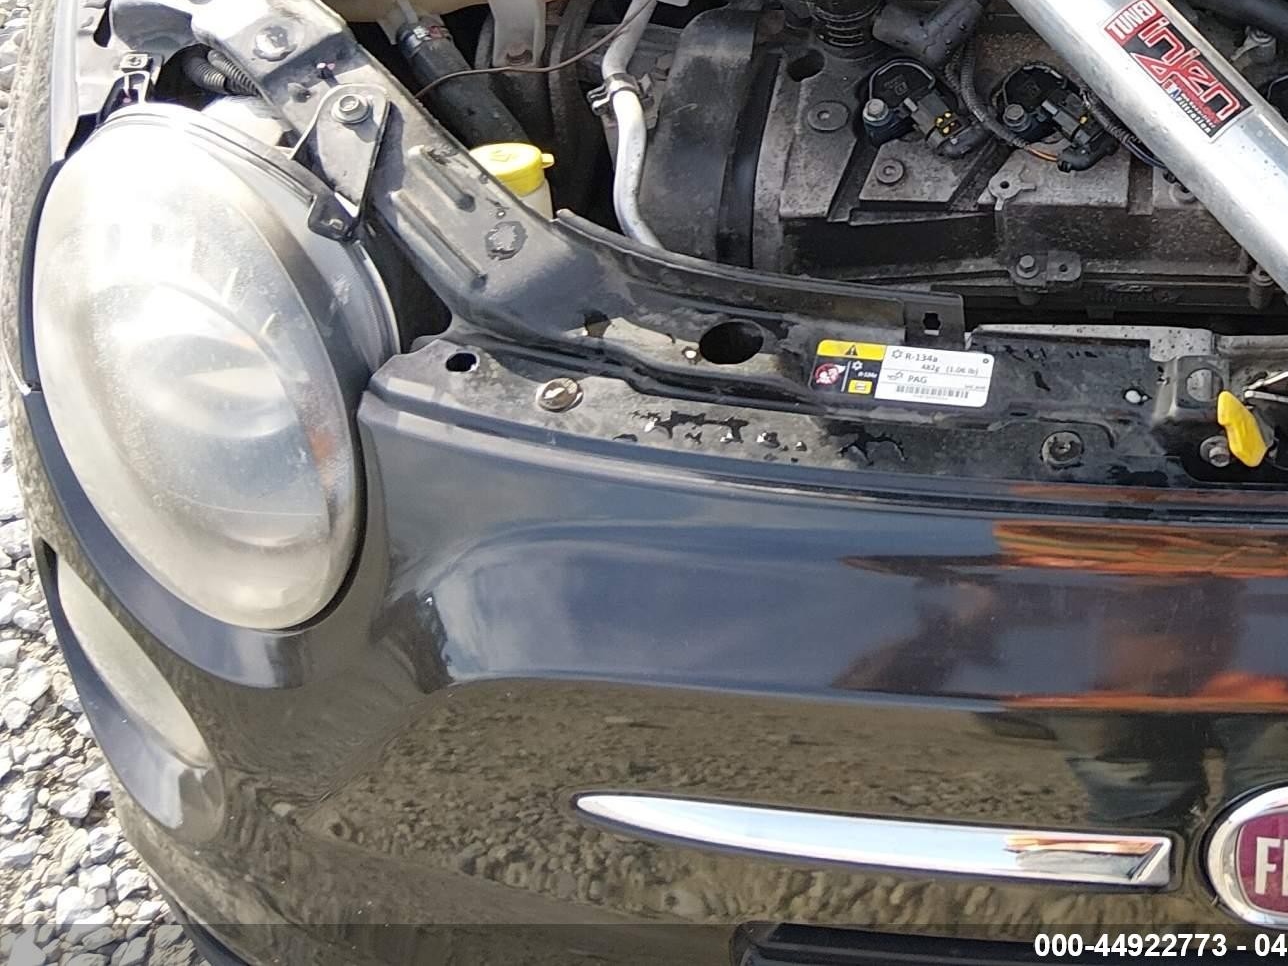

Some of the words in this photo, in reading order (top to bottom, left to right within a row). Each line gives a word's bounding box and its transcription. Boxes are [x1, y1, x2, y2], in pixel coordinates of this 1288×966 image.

[1107, 0, 1156, 40] TUNED
[905, 351, 938, 363] R-134a
[907, 375, 928, 384] PAG
